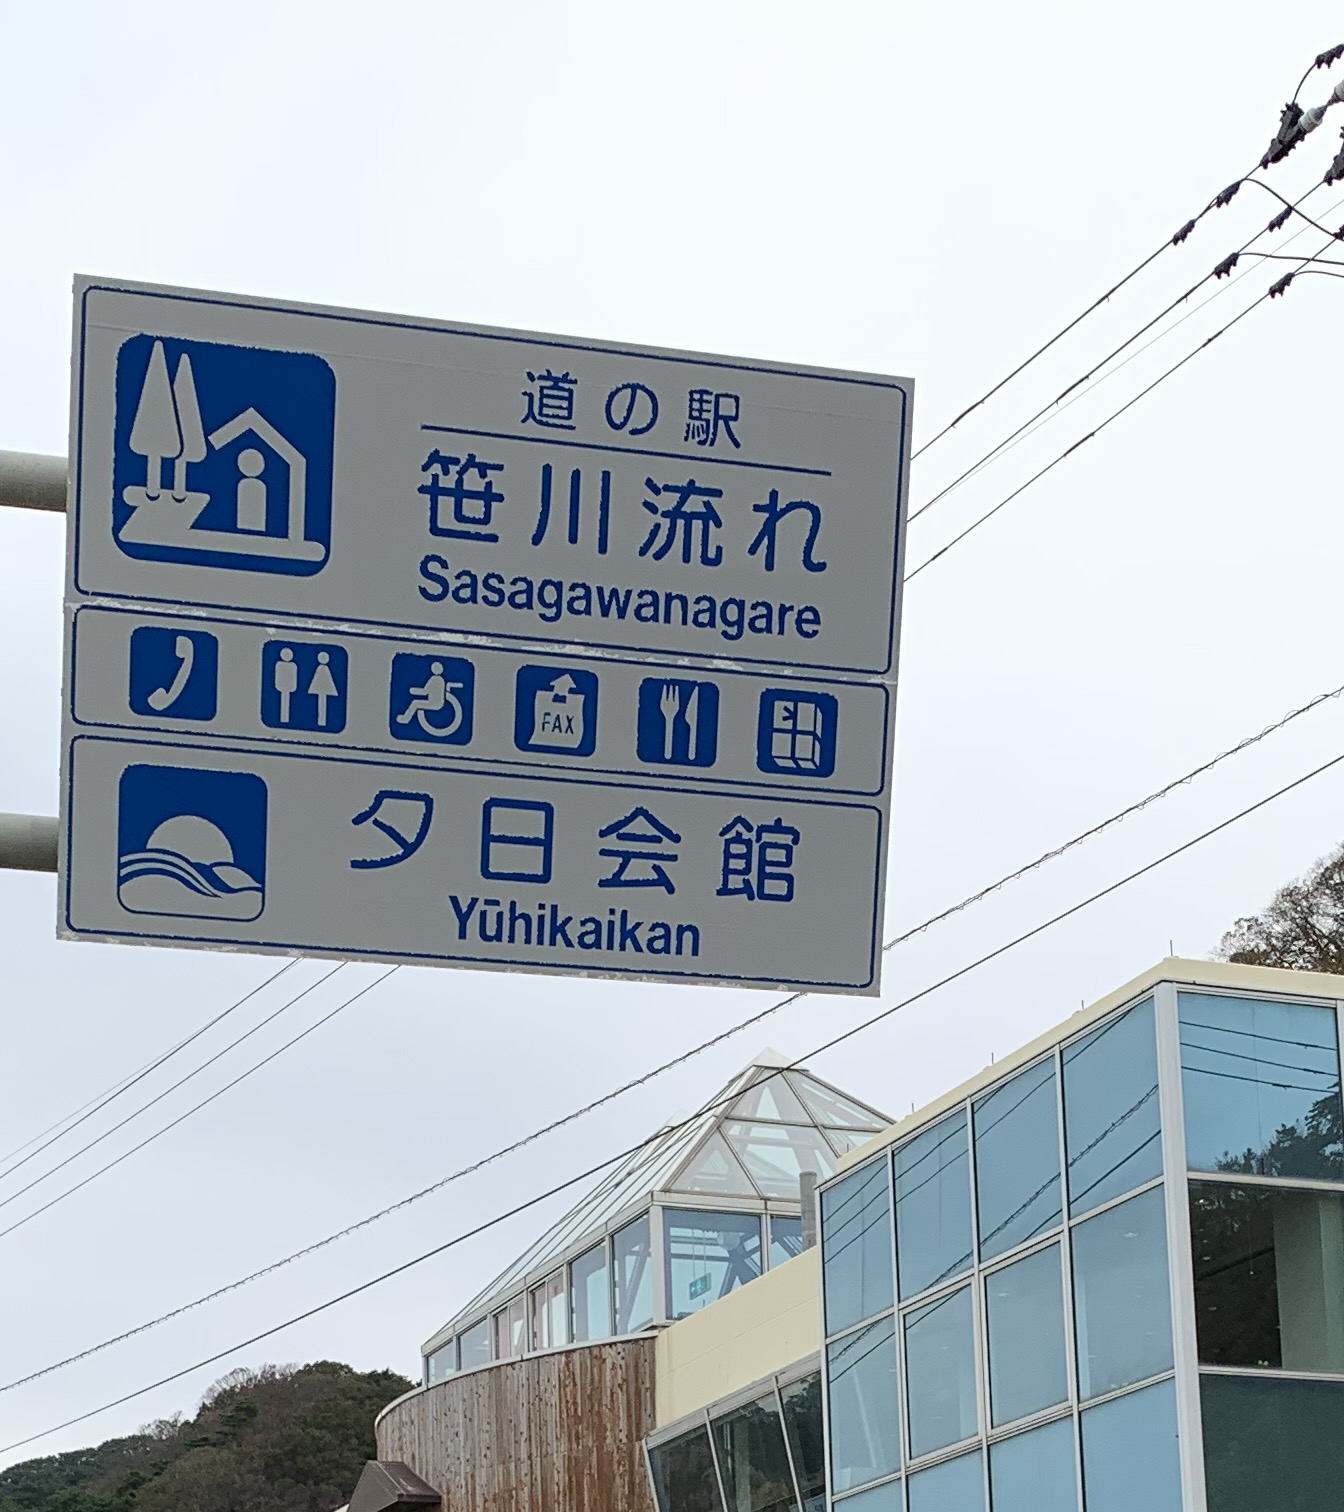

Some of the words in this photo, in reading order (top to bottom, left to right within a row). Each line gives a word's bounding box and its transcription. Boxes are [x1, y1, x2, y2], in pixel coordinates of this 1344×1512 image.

[521, 369, 742, 449] 道の駅
[418, 448, 827, 573] 笹川流れ
[418, 553, 822, 639] Sasagawanagare
[542, 712, 574, 734] FAX
[350, 789, 800, 903] 夕日会館
[449, 893, 701, 958] Yūhikaikan
